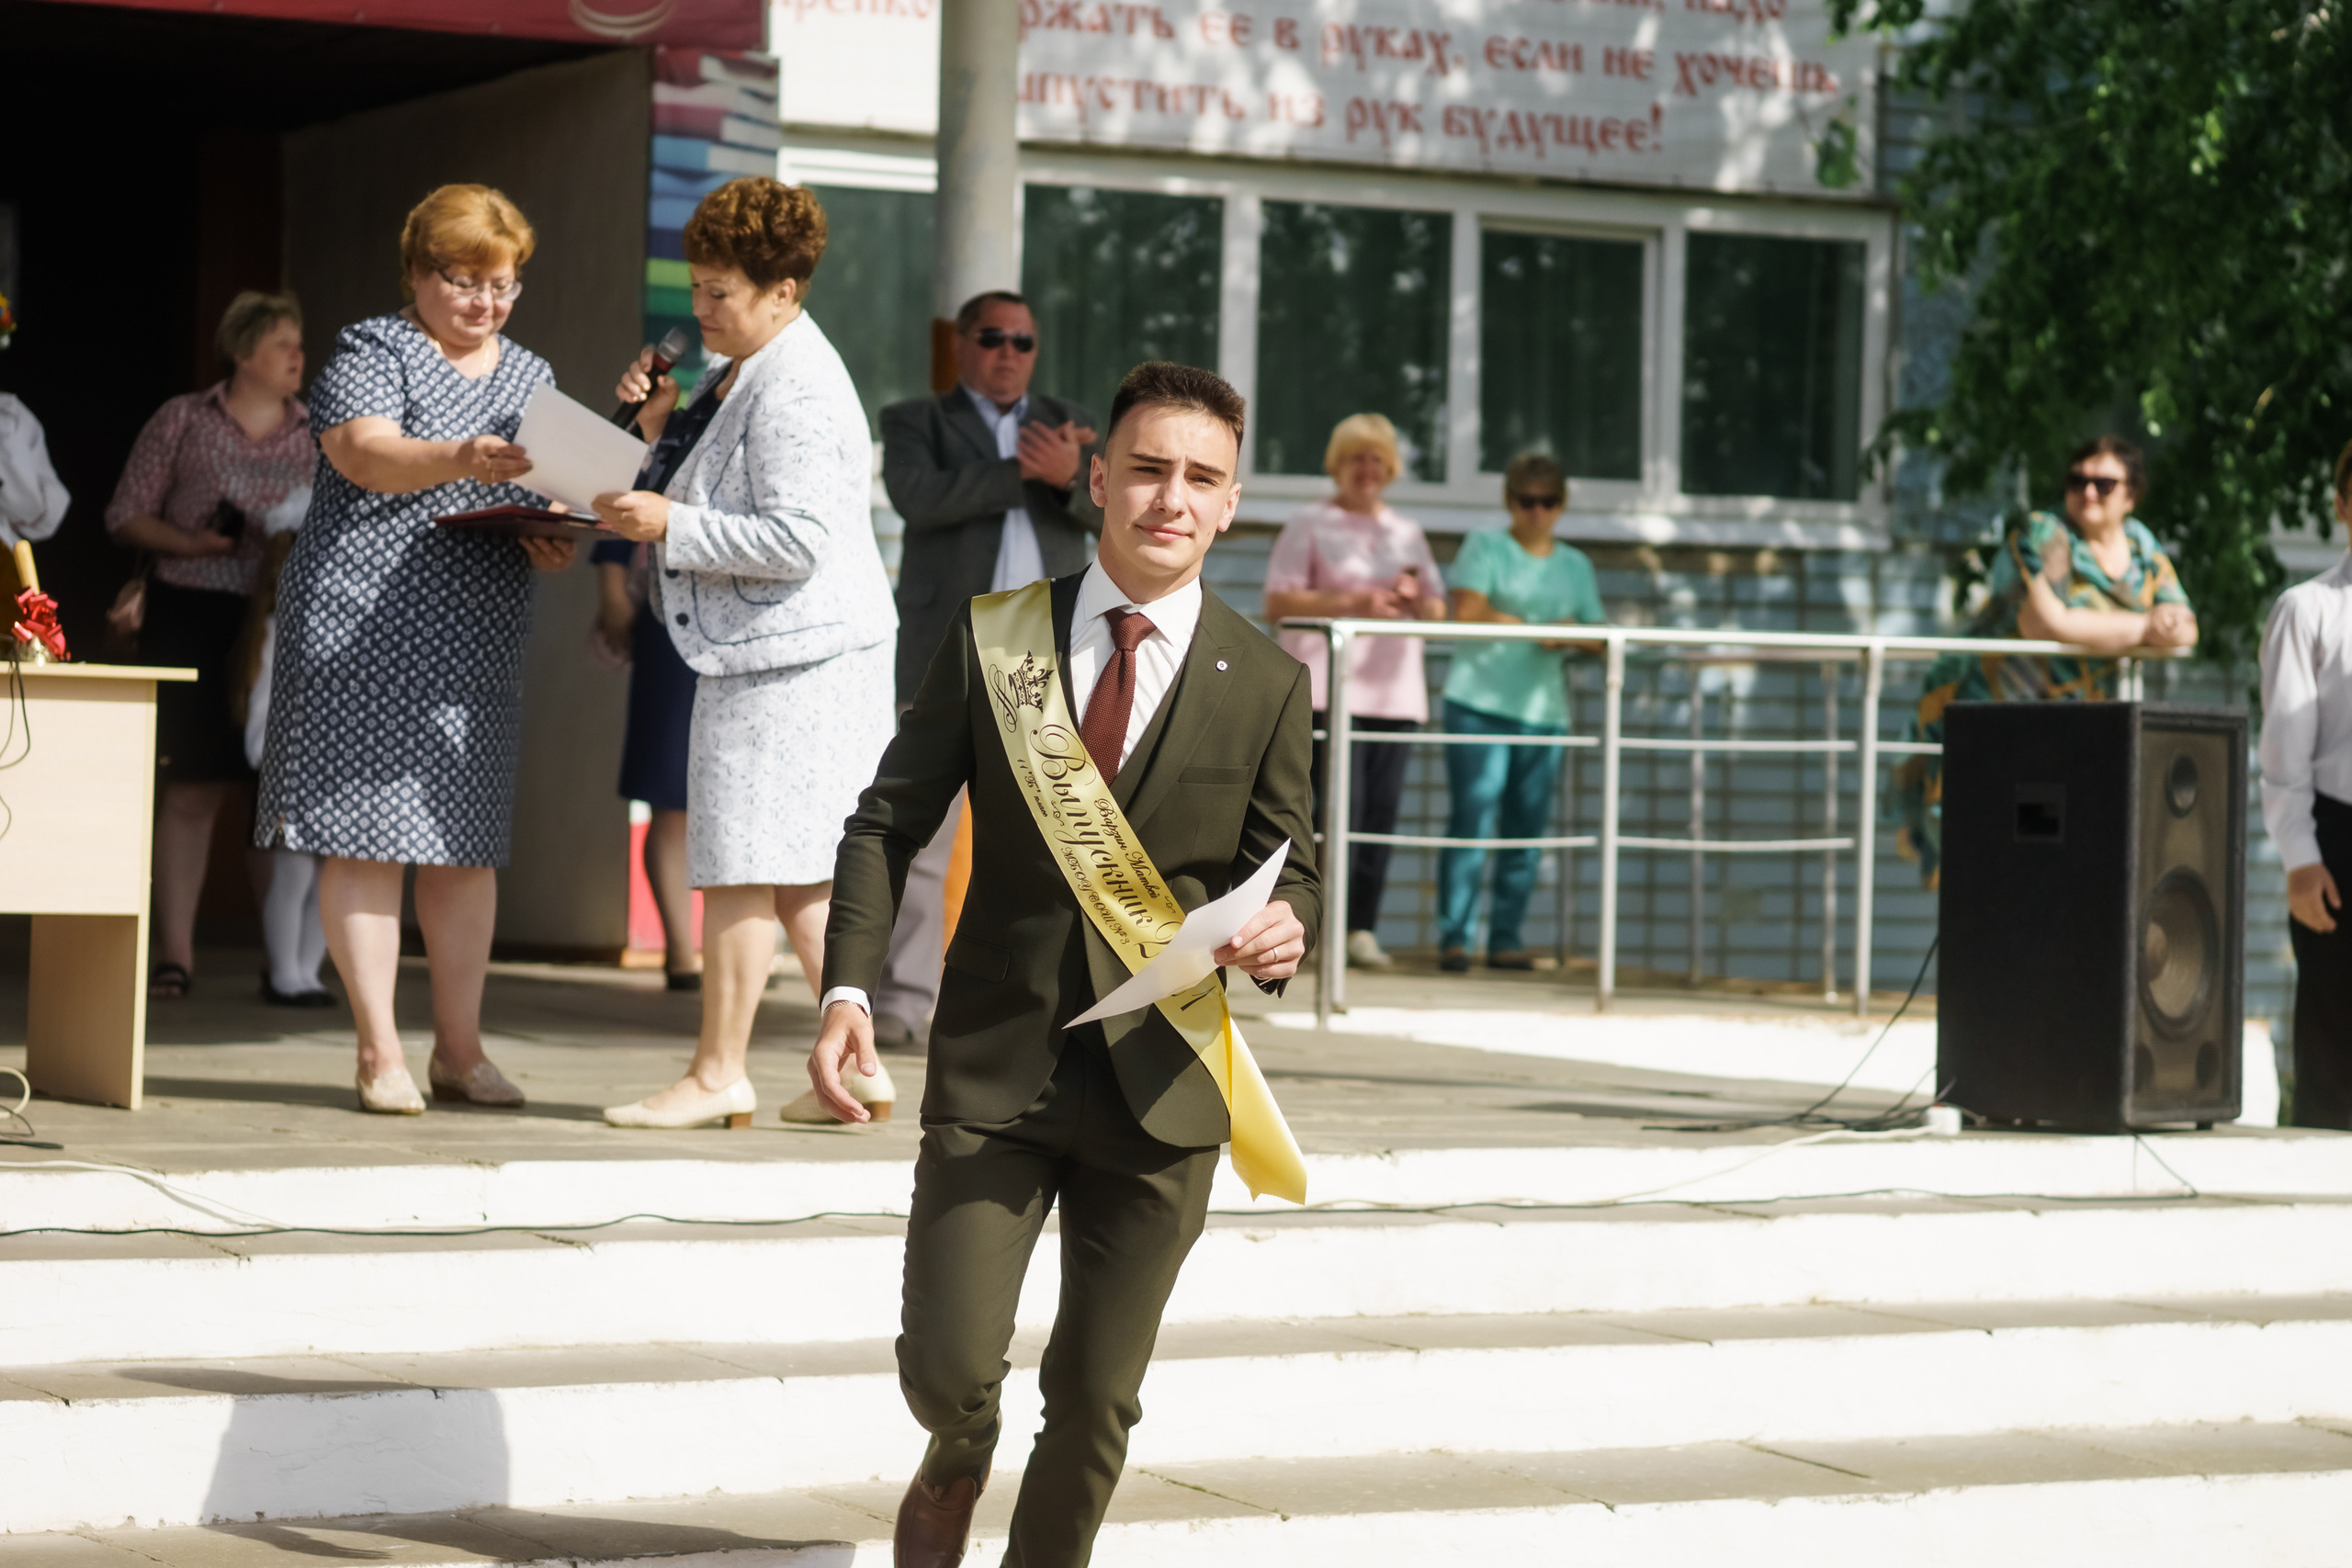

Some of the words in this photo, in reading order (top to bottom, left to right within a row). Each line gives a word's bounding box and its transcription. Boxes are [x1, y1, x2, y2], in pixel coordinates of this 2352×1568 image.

[1017, 0, 1177, 42] ржать
[1484, 35, 1584, 73] если
[1603, 45, 1656, 81] не
[1344, 96, 1423, 148] рук
[1442, 102, 1664, 160] будущее!
[1029, 724, 1153, 929] Выпускник
[1125, 851, 1161, 900] Матвей
